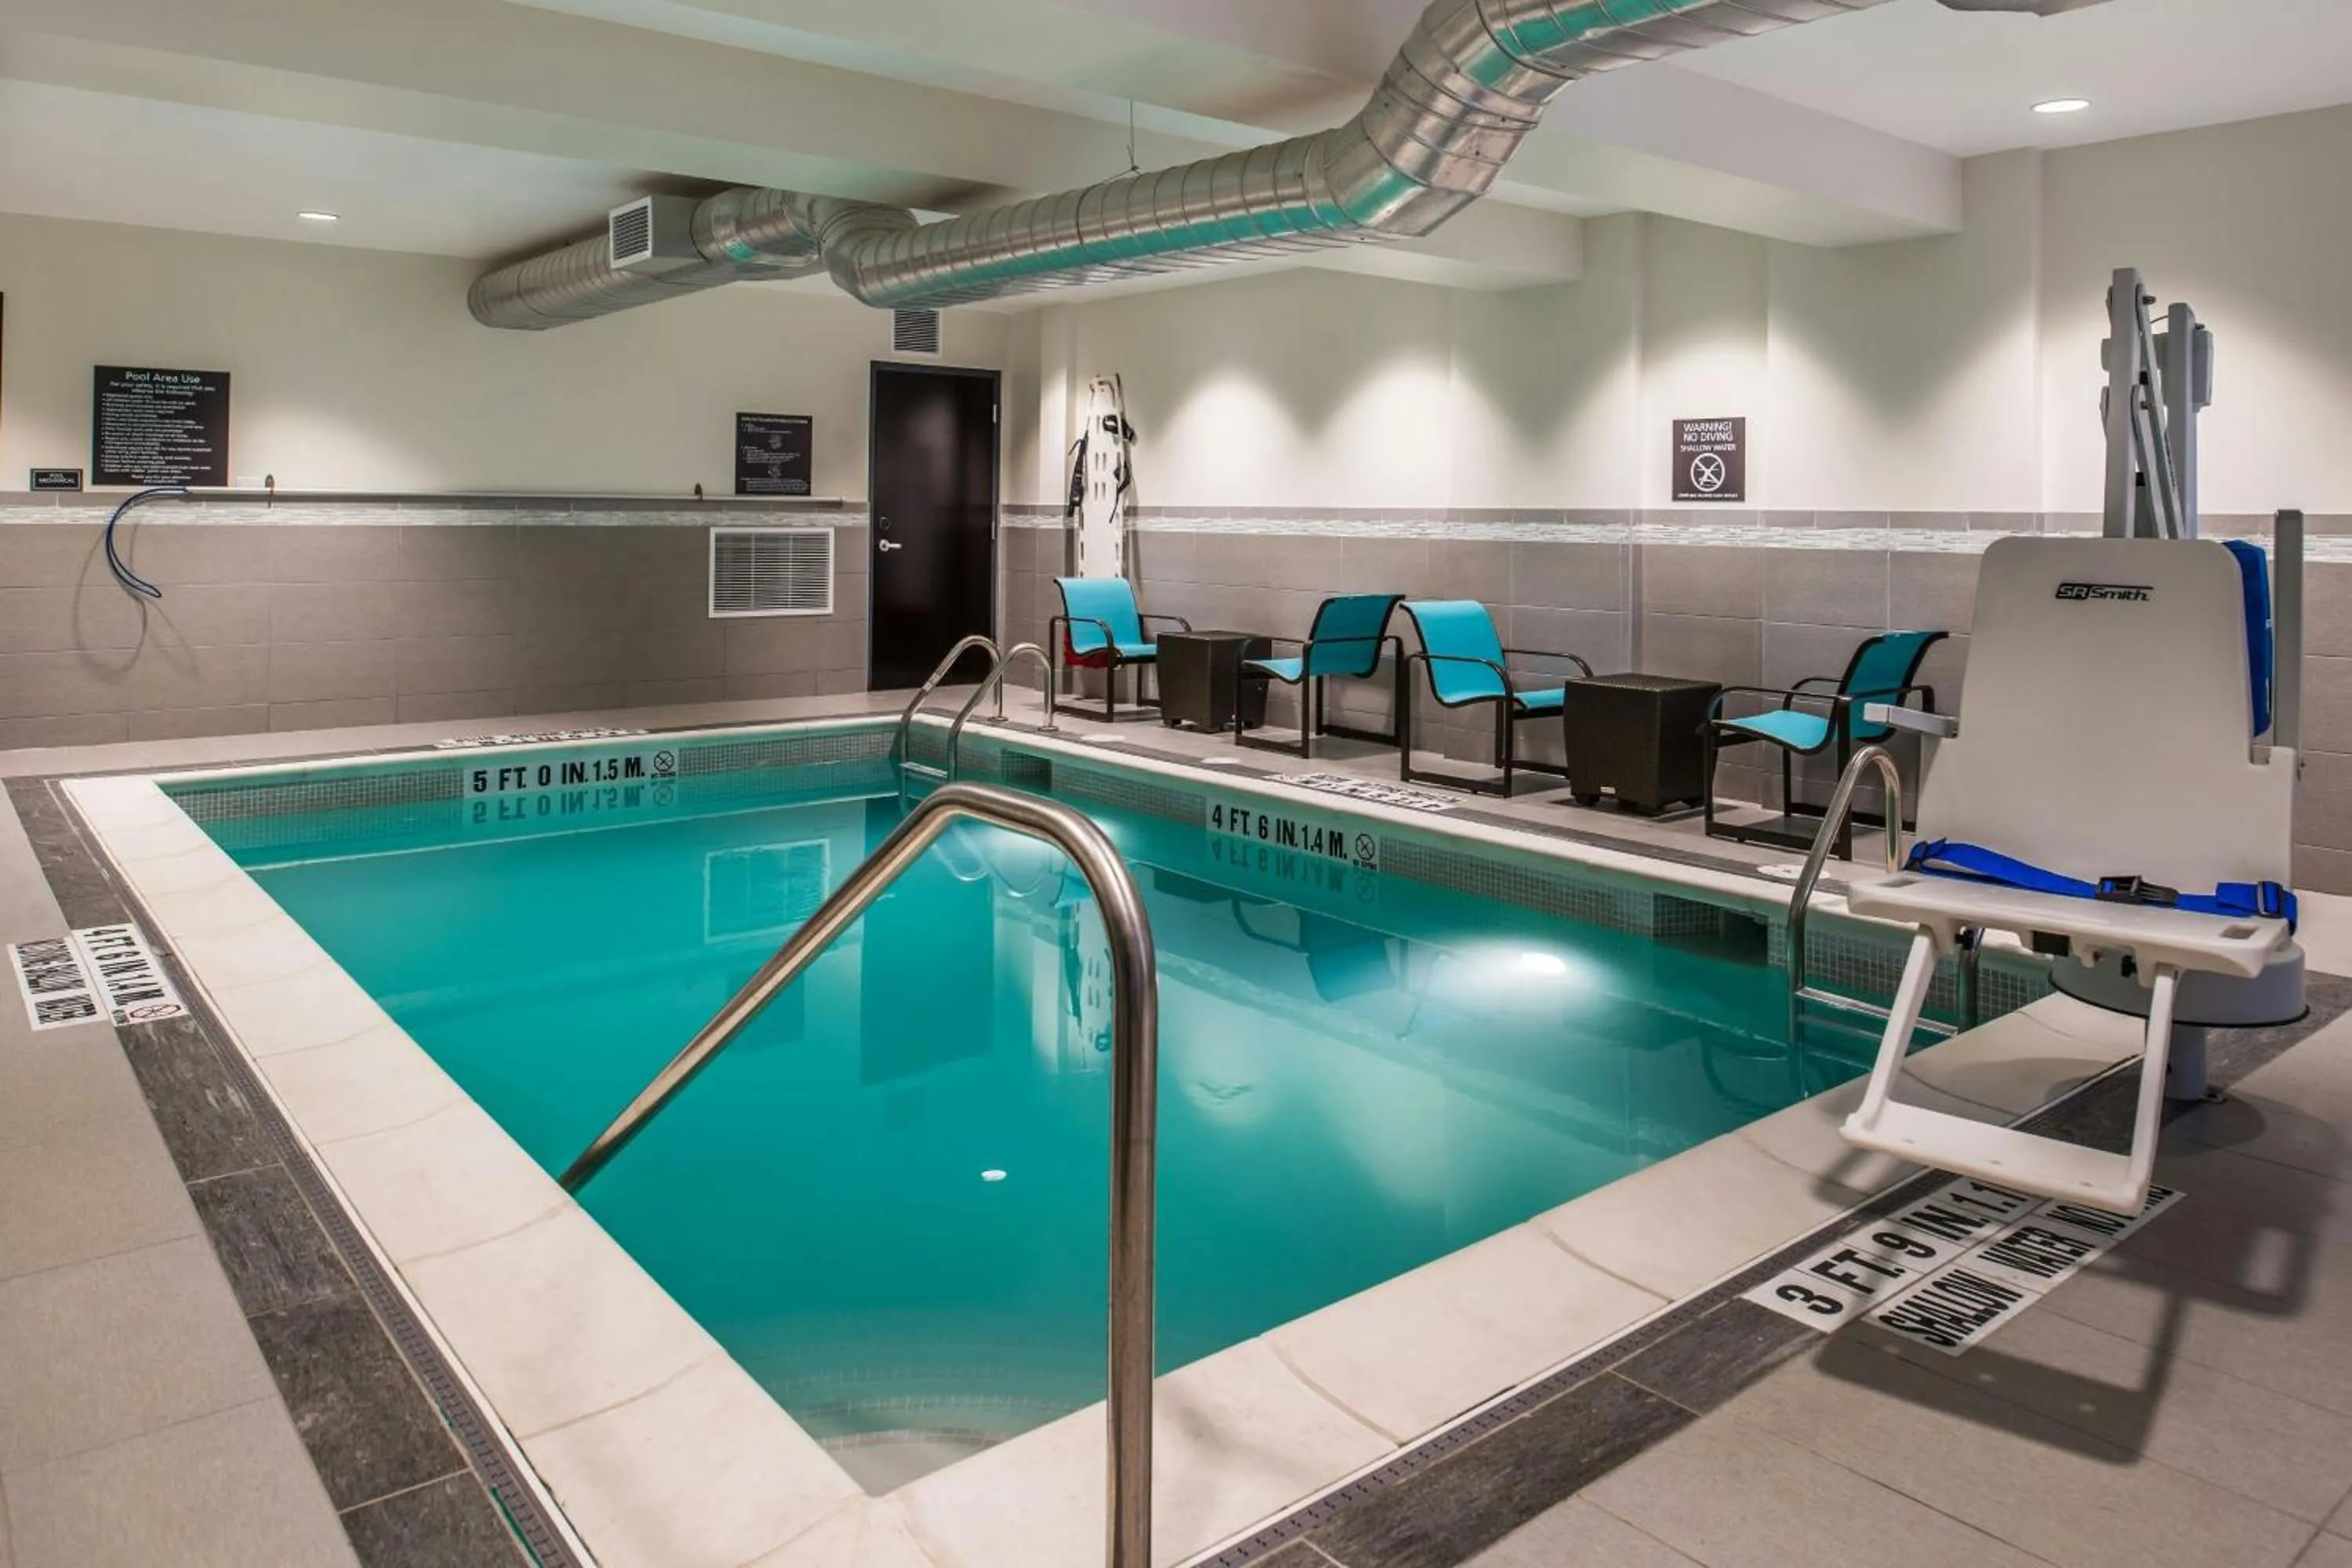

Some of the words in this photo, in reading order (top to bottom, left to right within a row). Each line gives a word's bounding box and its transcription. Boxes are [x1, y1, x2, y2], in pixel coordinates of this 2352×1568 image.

[125, 371, 150, 381] Pool
[153, 372, 179, 383] Area
[180, 373, 201, 383] Use
[1683, 432, 1697, 441] NO
[1700, 431, 1733, 441] DIVING
[473, 770, 488, 793] 5
[499, 767, 528, 791] FT.
[561, 761, 589, 785] IN.
[593, 759, 618, 782] 1.5
[624, 757, 645, 779] M.
[1212, 804, 1222, 829] 4
[1230, 808, 1250, 837] FT.
[1258, 815, 1268, 839] 6
[1276, 818, 1298, 848] IN.
[1301, 825, 1323, 854] 1.4
[1329, 830, 1348, 860] M.
[1949, 1181, 2027, 1214] 1.1
[1900, 1204, 1990, 1241] IN.
[1871, 1231, 1937, 1258] 9
[1810, 1247, 1906, 1295] FT.
[1878, 1269, 2024, 1347] SHALLOW
[1976, 1225, 2096, 1279] WATER
[2045, 1205, 2125, 1236] NO
[1775, 1284, 1844, 1315] 3
